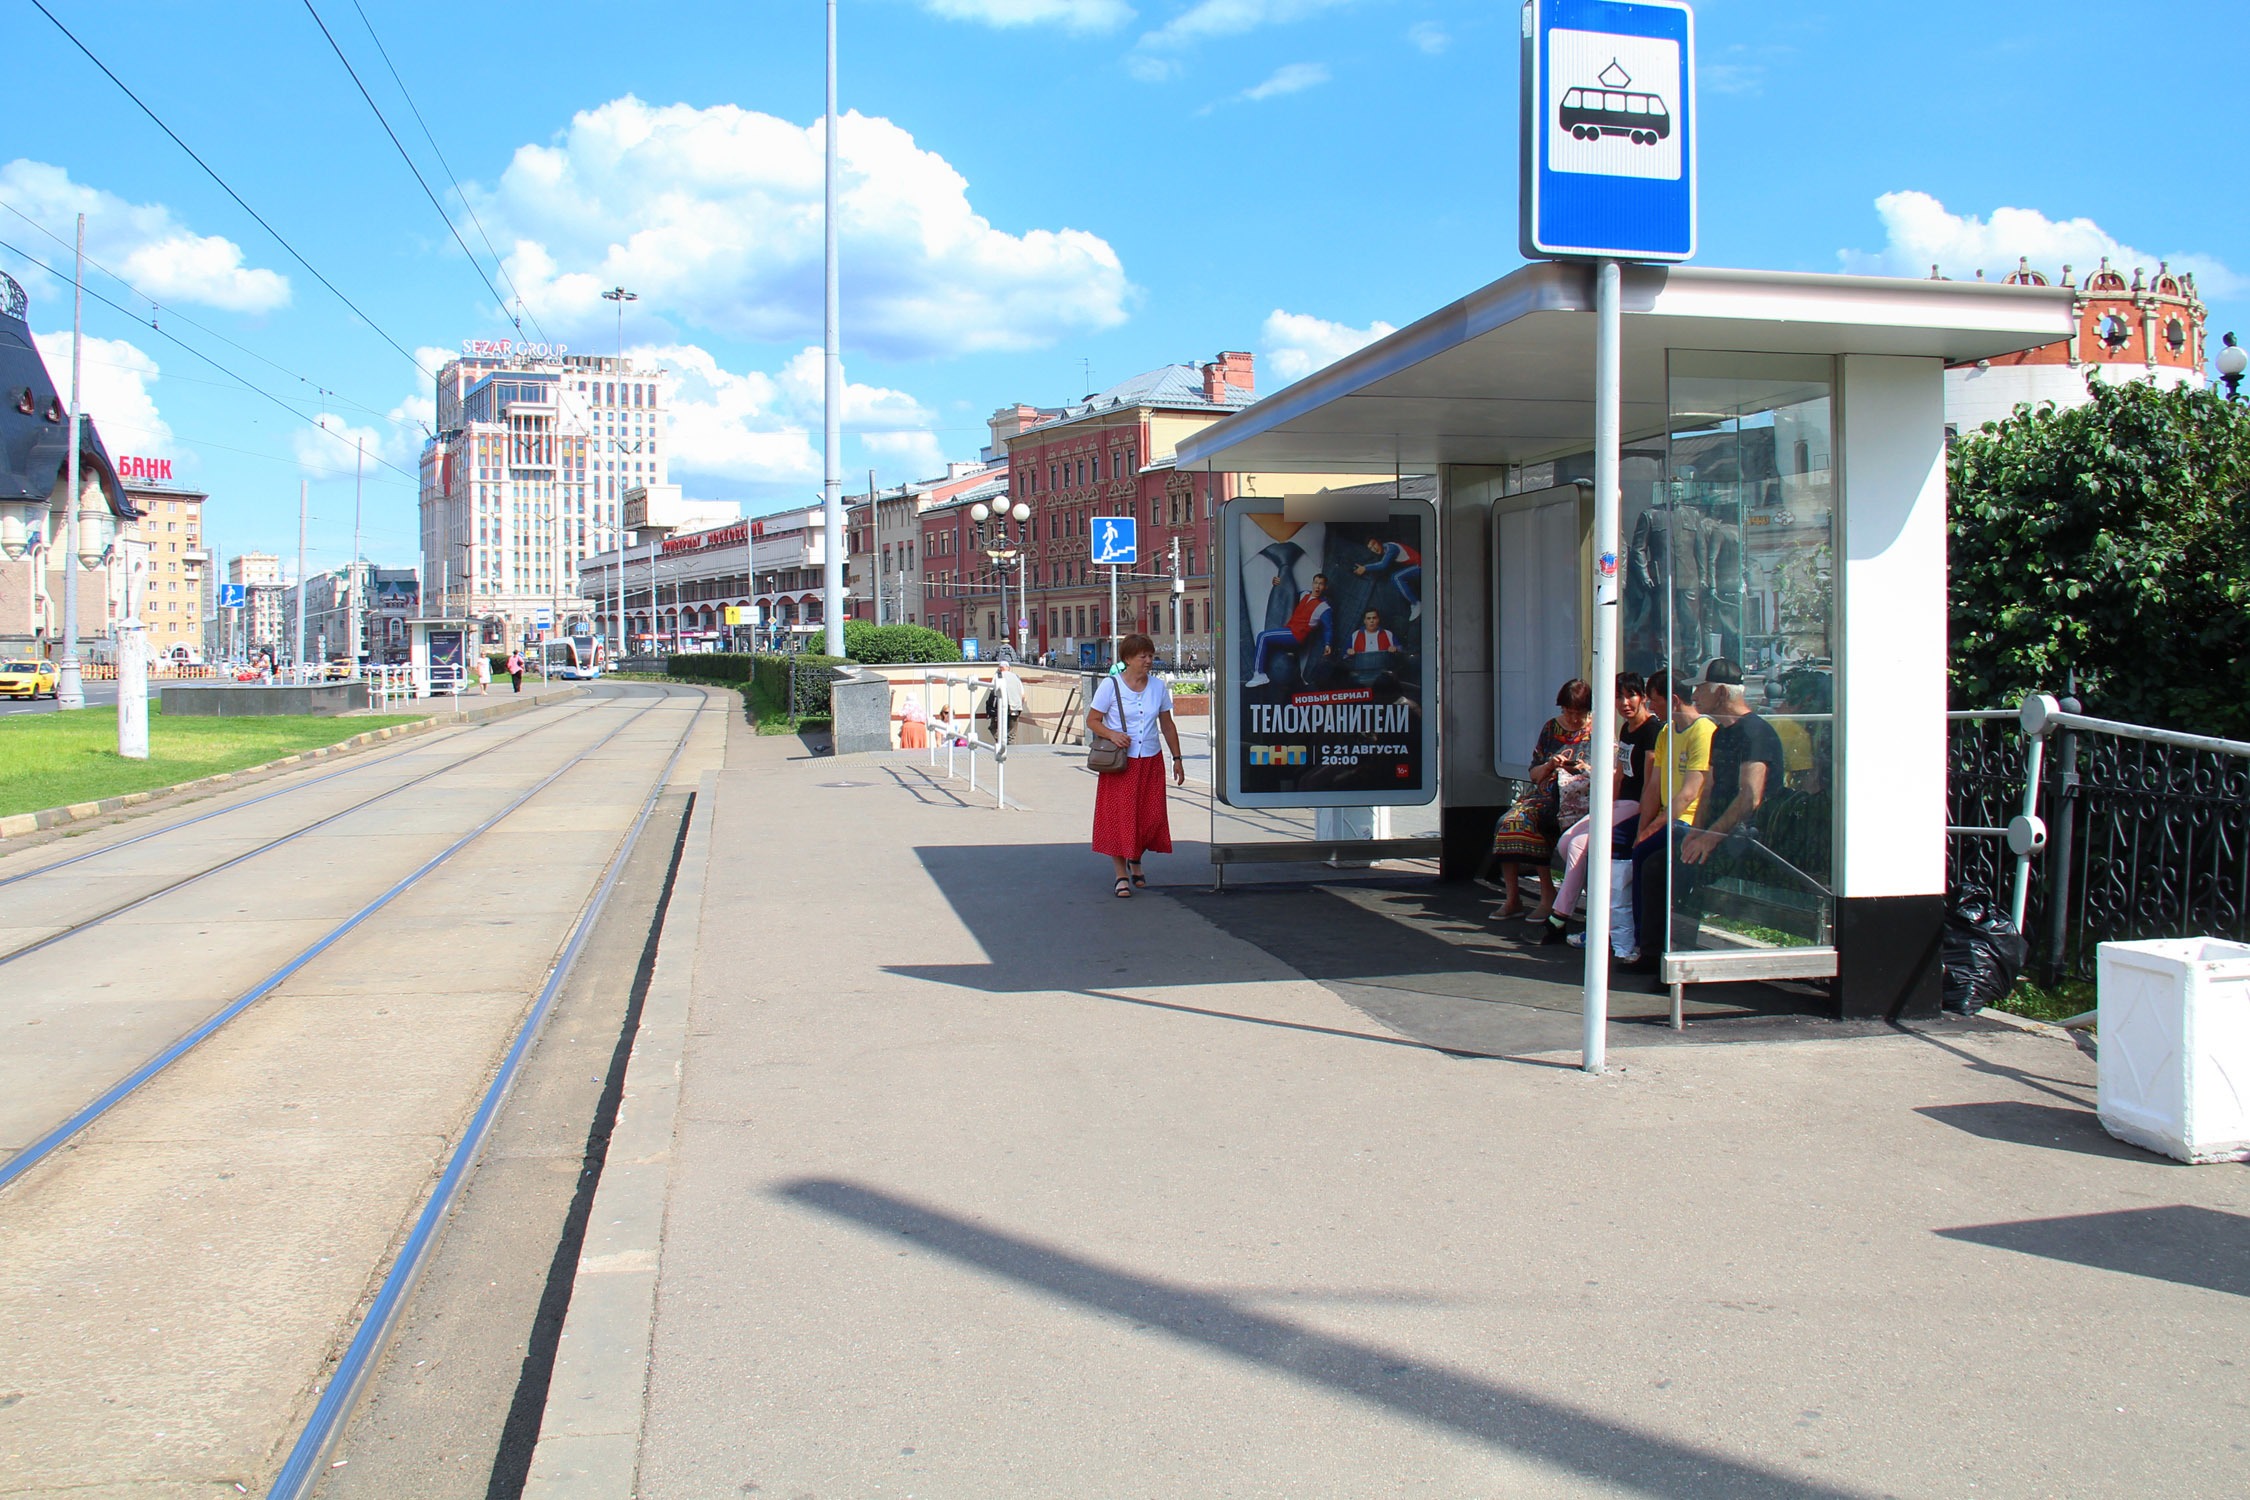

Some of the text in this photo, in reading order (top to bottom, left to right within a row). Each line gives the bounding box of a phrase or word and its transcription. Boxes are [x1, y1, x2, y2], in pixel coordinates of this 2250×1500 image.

[462, 339, 568, 358] SEZAR GROUP
[119, 455, 173, 479] БАНК
[1295, 690, 1370, 704] НОВЫЙ СЕРИАЛ
[1250, 704, 1409, 733] ТЕЛОХРАНИТЕЛИ
[1250, 745, 1307, 765] ТНТ
[1321, 745, 1409, 755] С 21 АВГУСТА
[1321, 755, 1359, 765] 20:00
